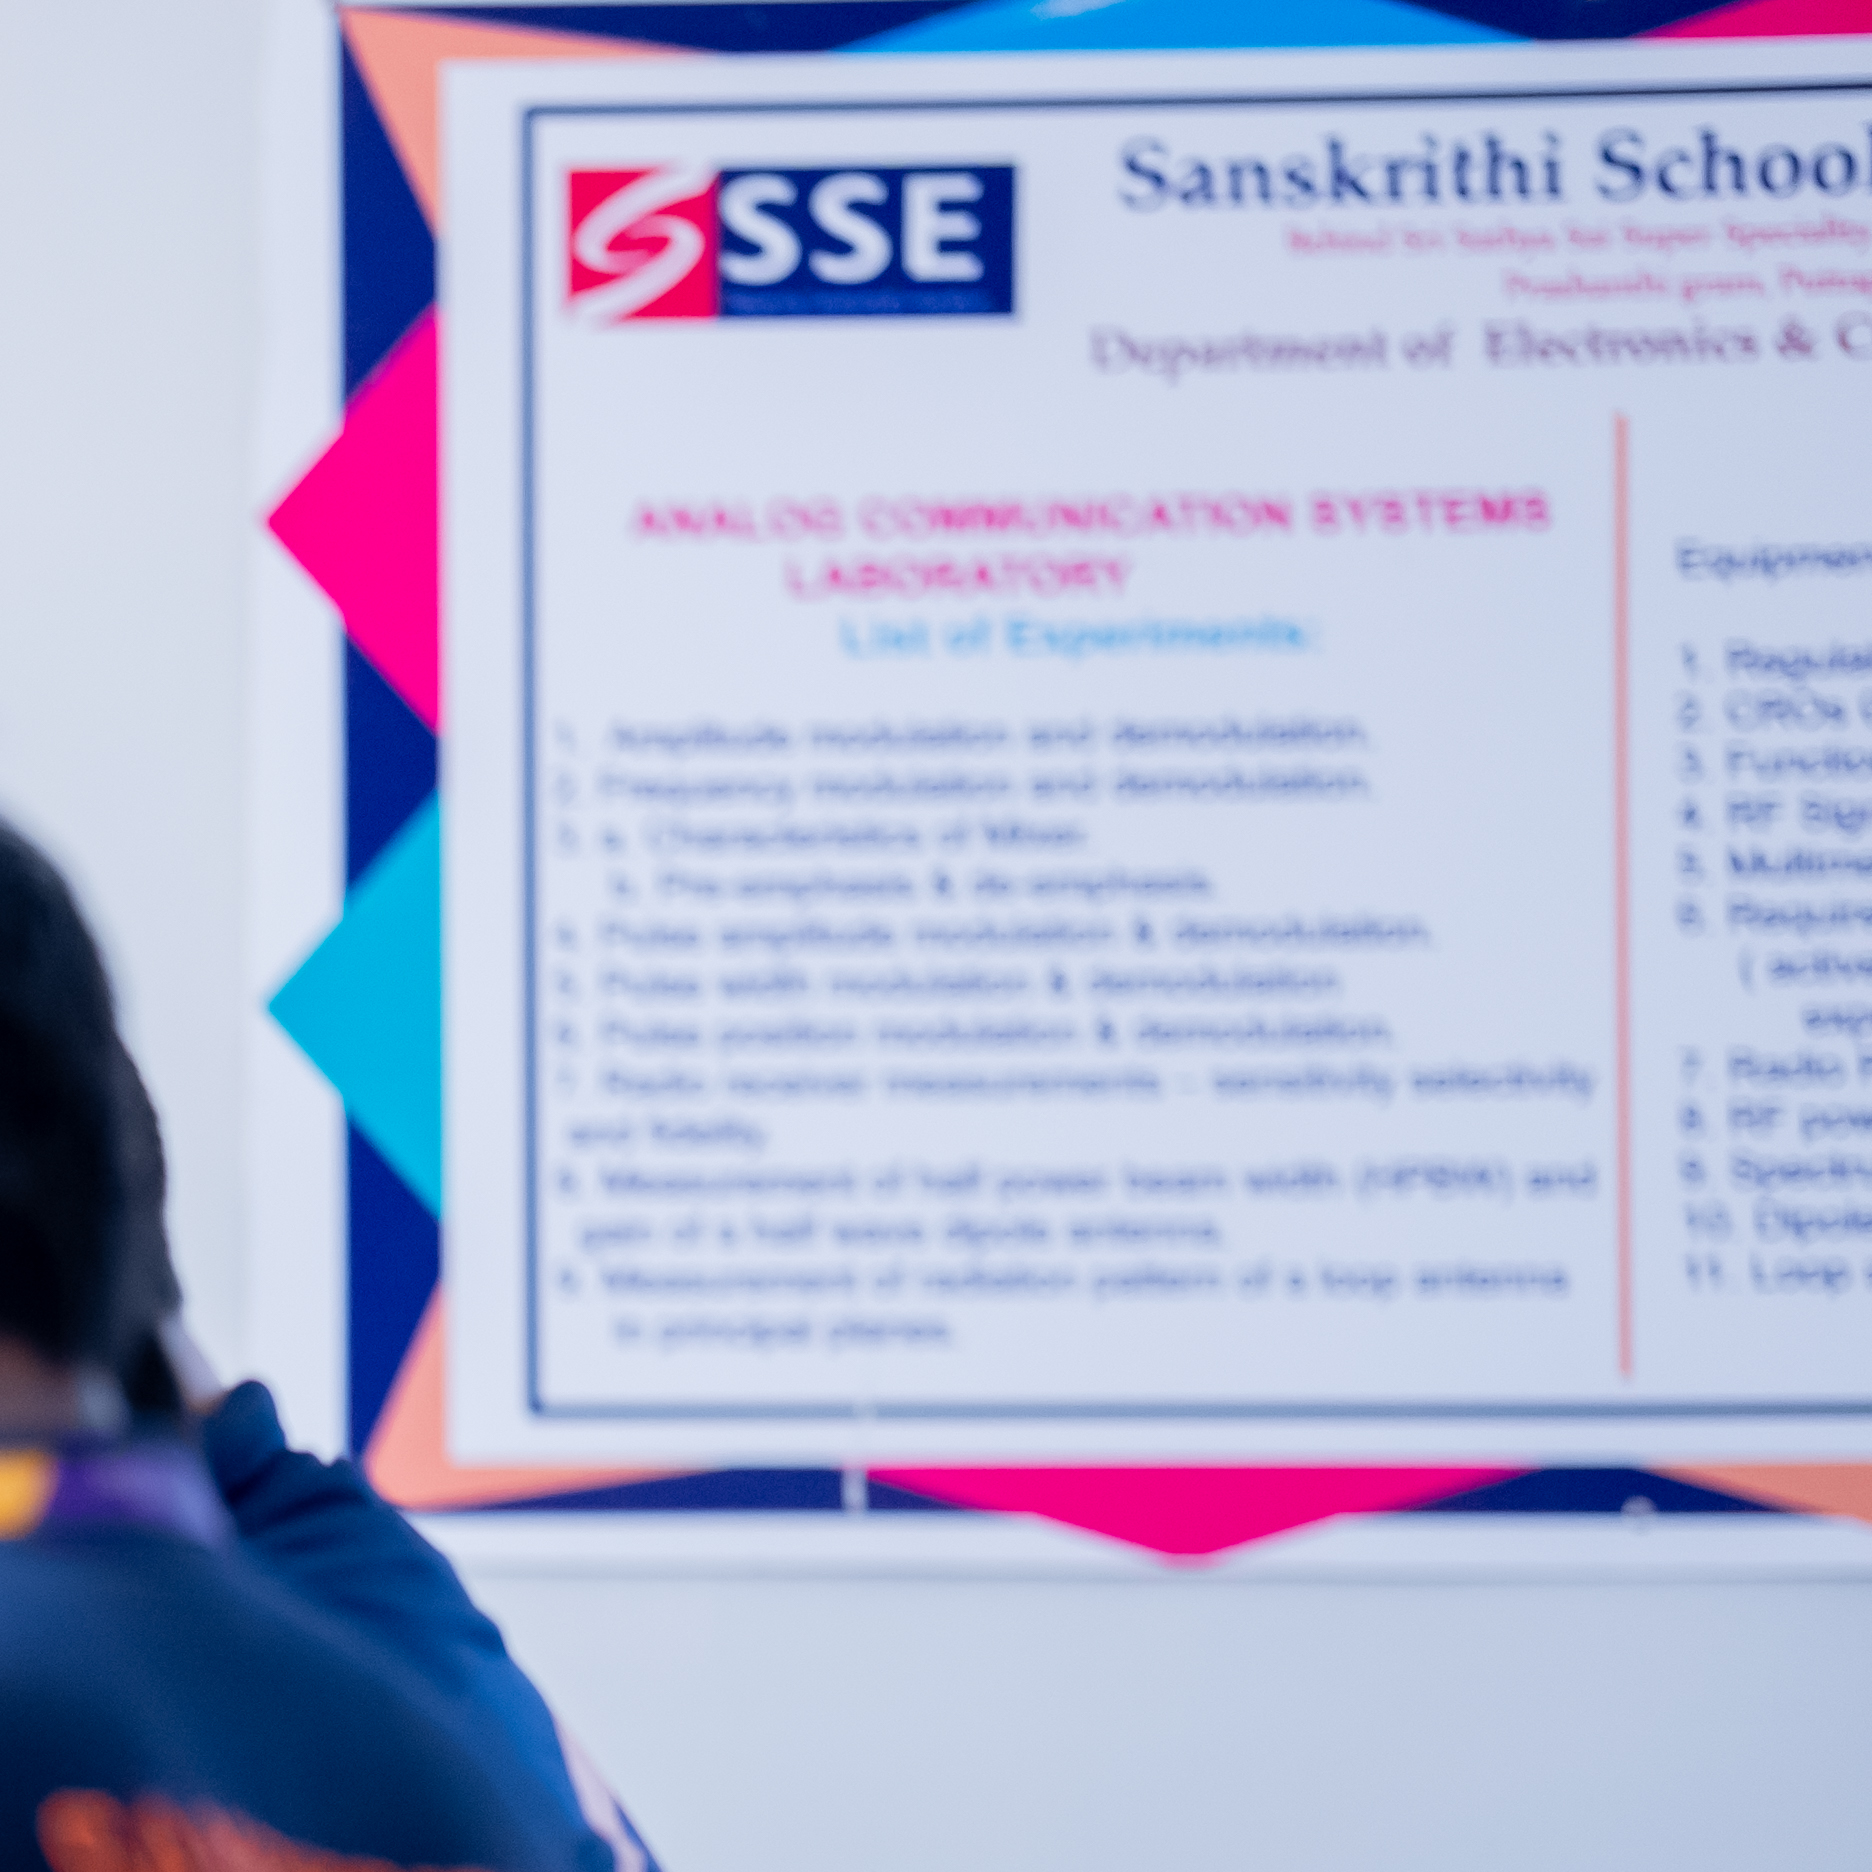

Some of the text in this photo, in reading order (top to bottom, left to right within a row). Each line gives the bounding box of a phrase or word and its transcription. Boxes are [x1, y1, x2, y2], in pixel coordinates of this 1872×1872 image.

[1116, 128, 1564, 212] Sanskrithi
[719, 173, 982, 284] SSE
[1089, 323, 1391, 387] Department
[1402, 318, 1455, 370] of
[1482, 313, 1762, 368] Electronics
[1775, 316, 1816, 363] &
[632, 486, 1553, 546] ANALOG COMMUNICATION SYSTEMS
[781, 553, 1133, 605] LABORATORY
[839, 614, 929, 660] List
[942, 610, 993, 658] of
